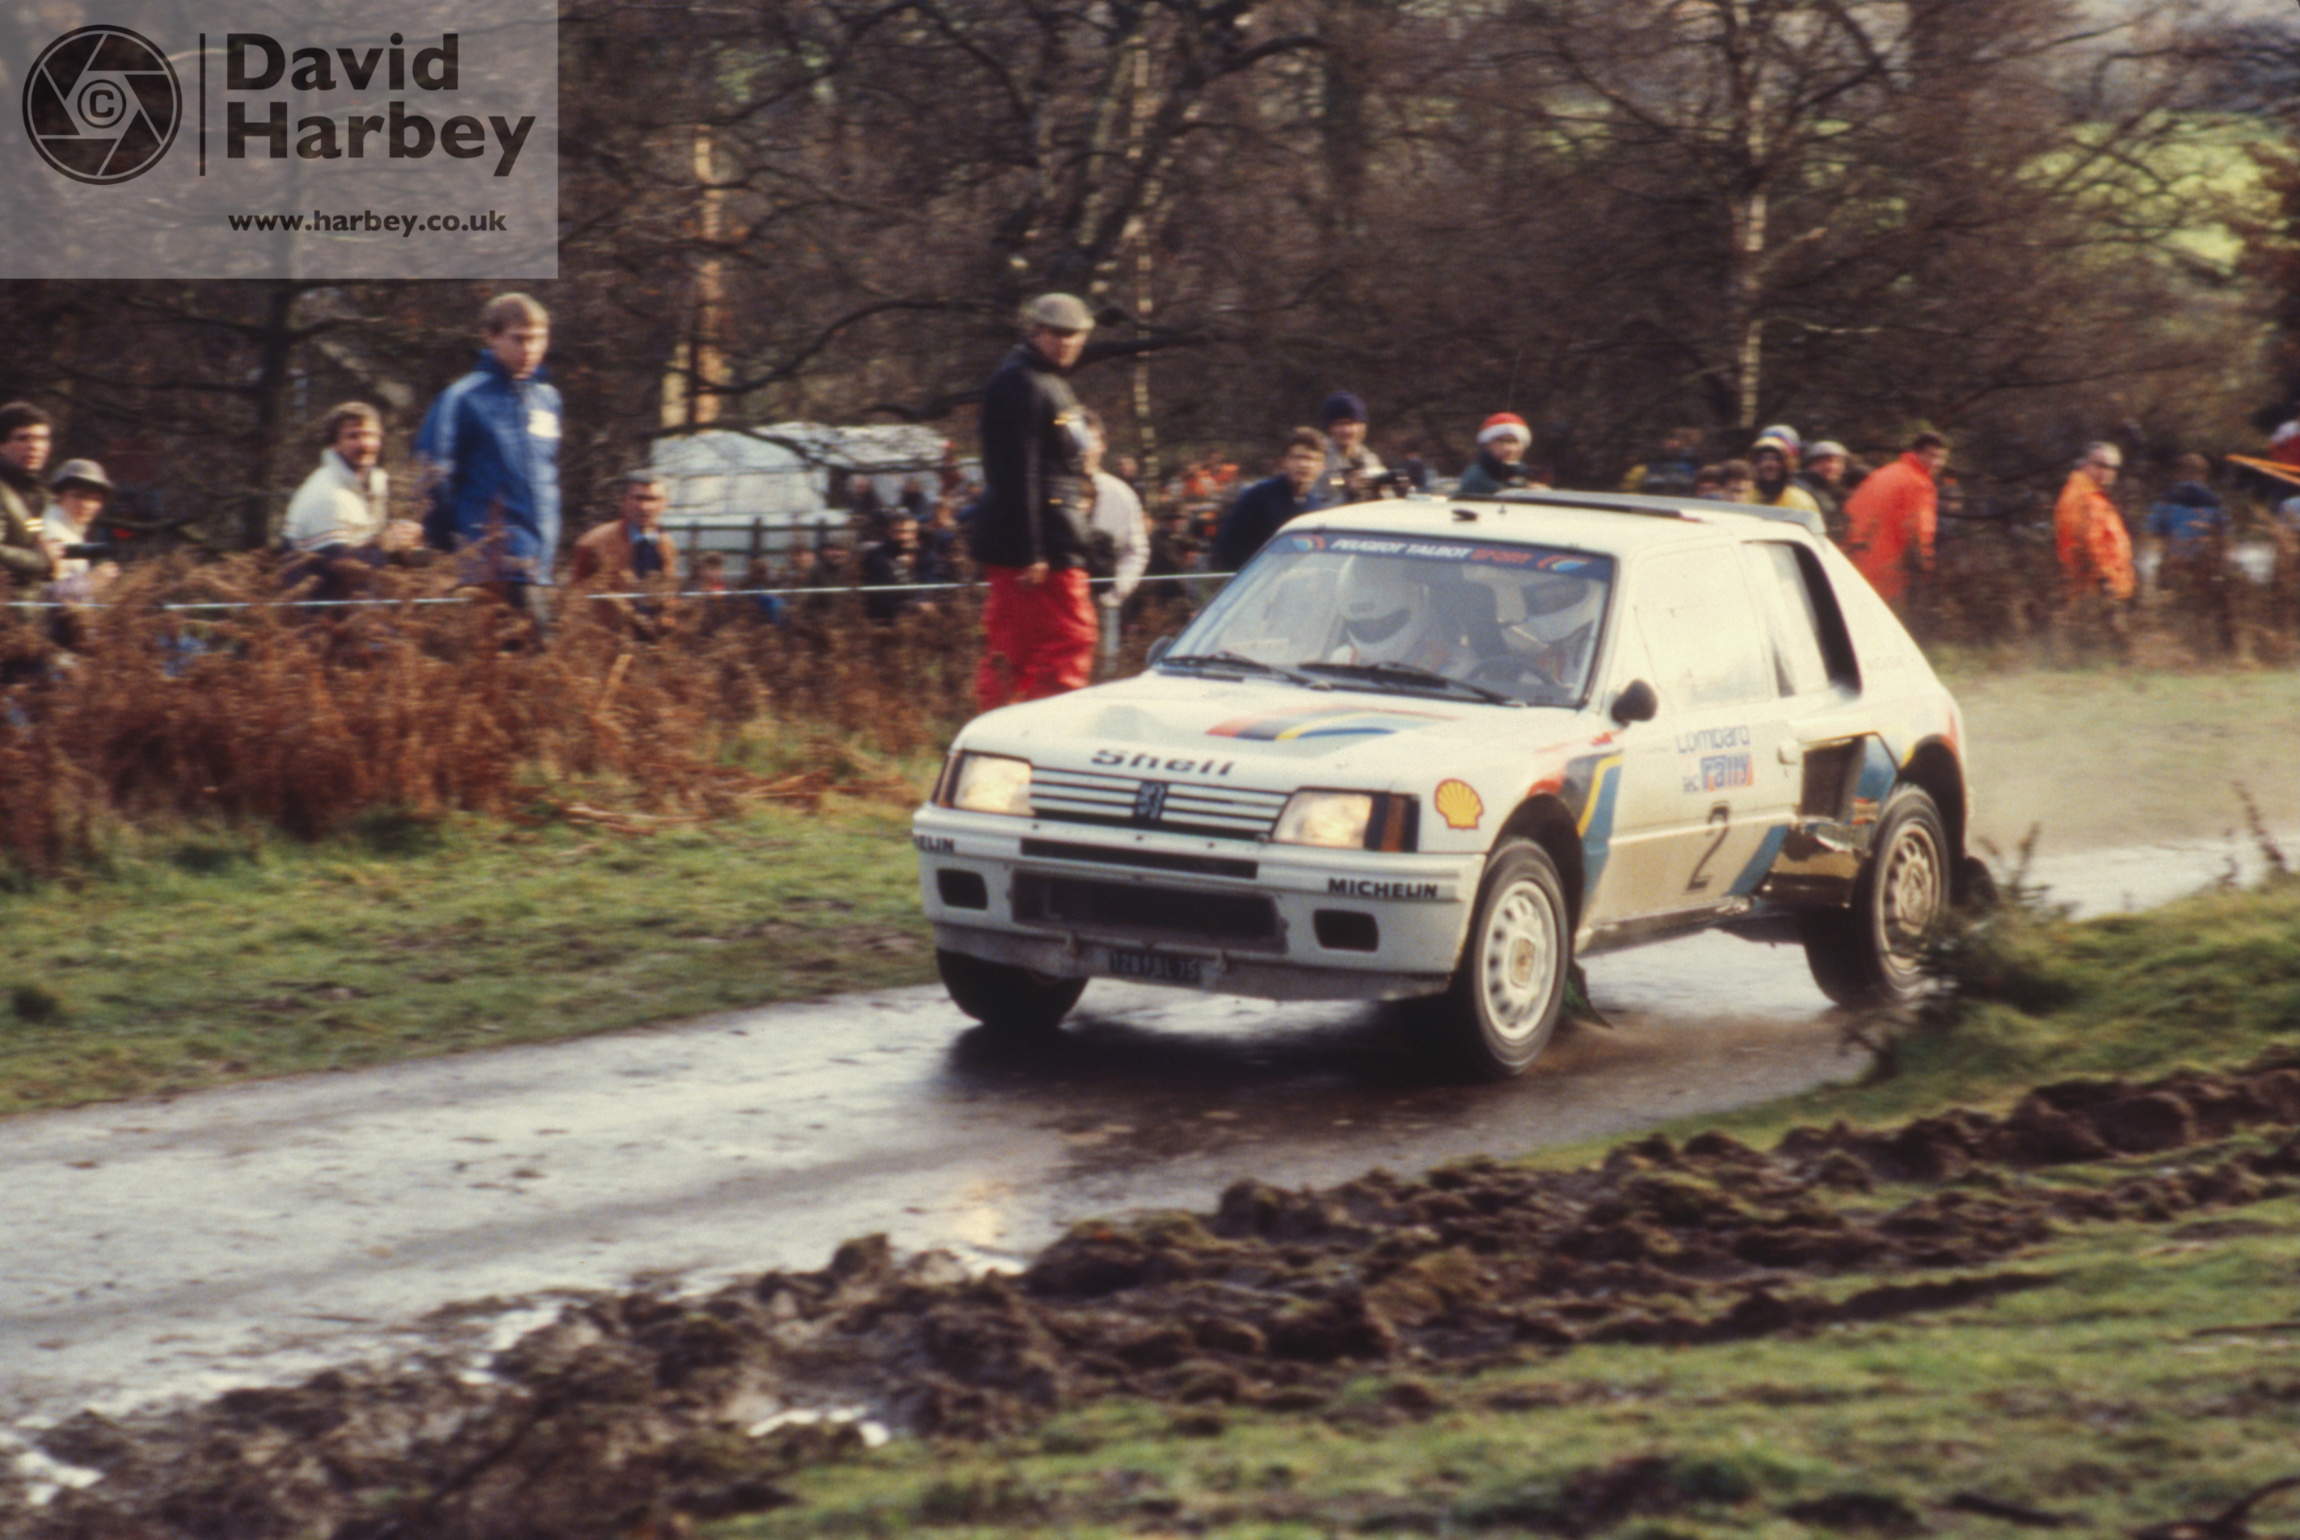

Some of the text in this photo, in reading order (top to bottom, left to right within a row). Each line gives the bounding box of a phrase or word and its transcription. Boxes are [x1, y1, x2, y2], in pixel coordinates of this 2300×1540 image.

[1405, 544, 1474, 559] TALBOT
[1091, 749, 1235, 776] Shell
[1682, 799, 1732, 895] 2
[1327, 878, 1439, 899] MICHELIN
